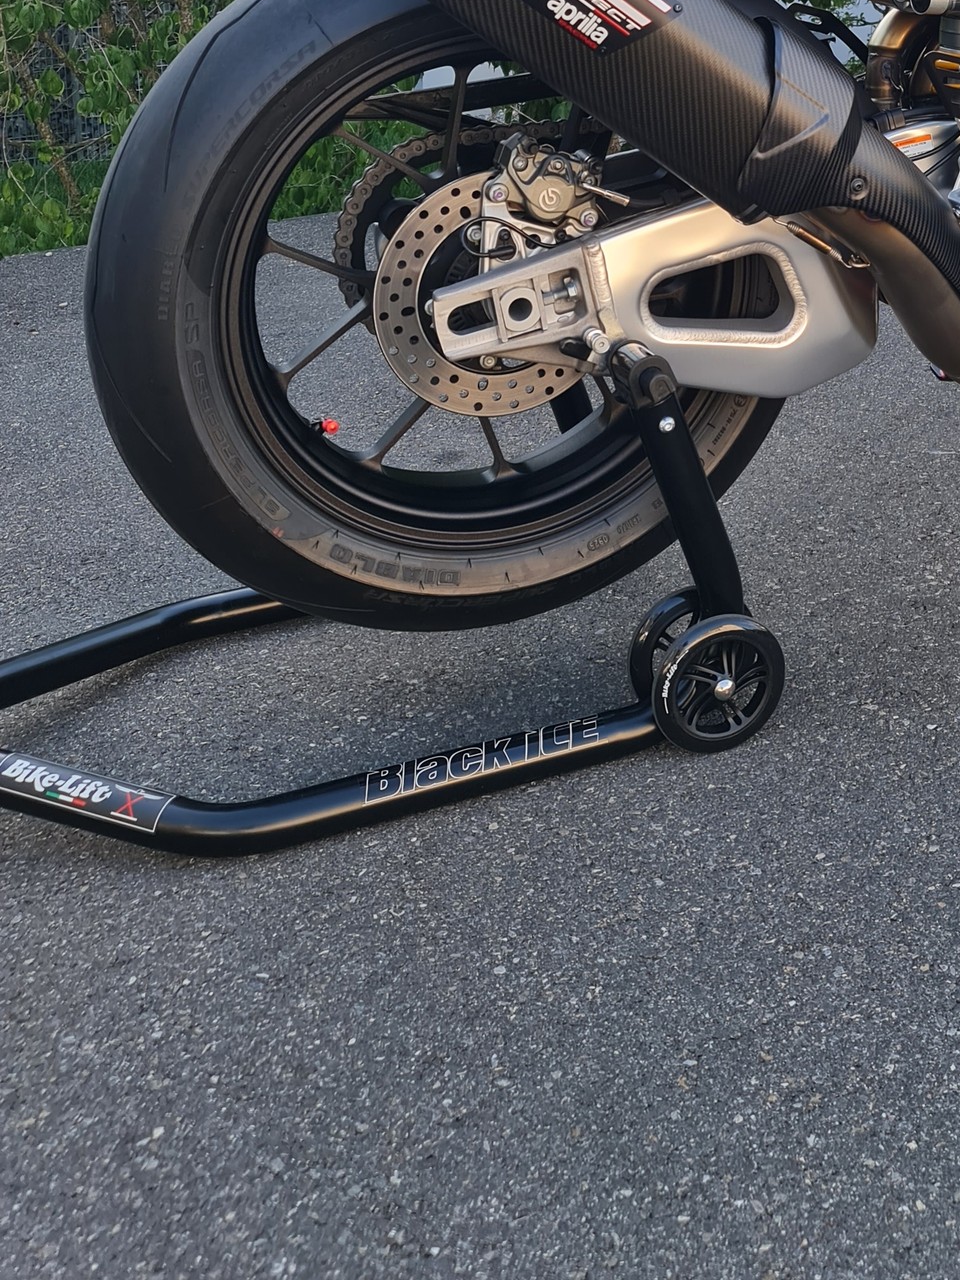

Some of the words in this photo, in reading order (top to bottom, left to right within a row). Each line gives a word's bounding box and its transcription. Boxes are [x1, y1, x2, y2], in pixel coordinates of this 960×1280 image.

[329, 542, 462, 587] DIABLO
[524, 713, 601, 762] ICE
[1, 759, 113, 803] Bike-Lift
